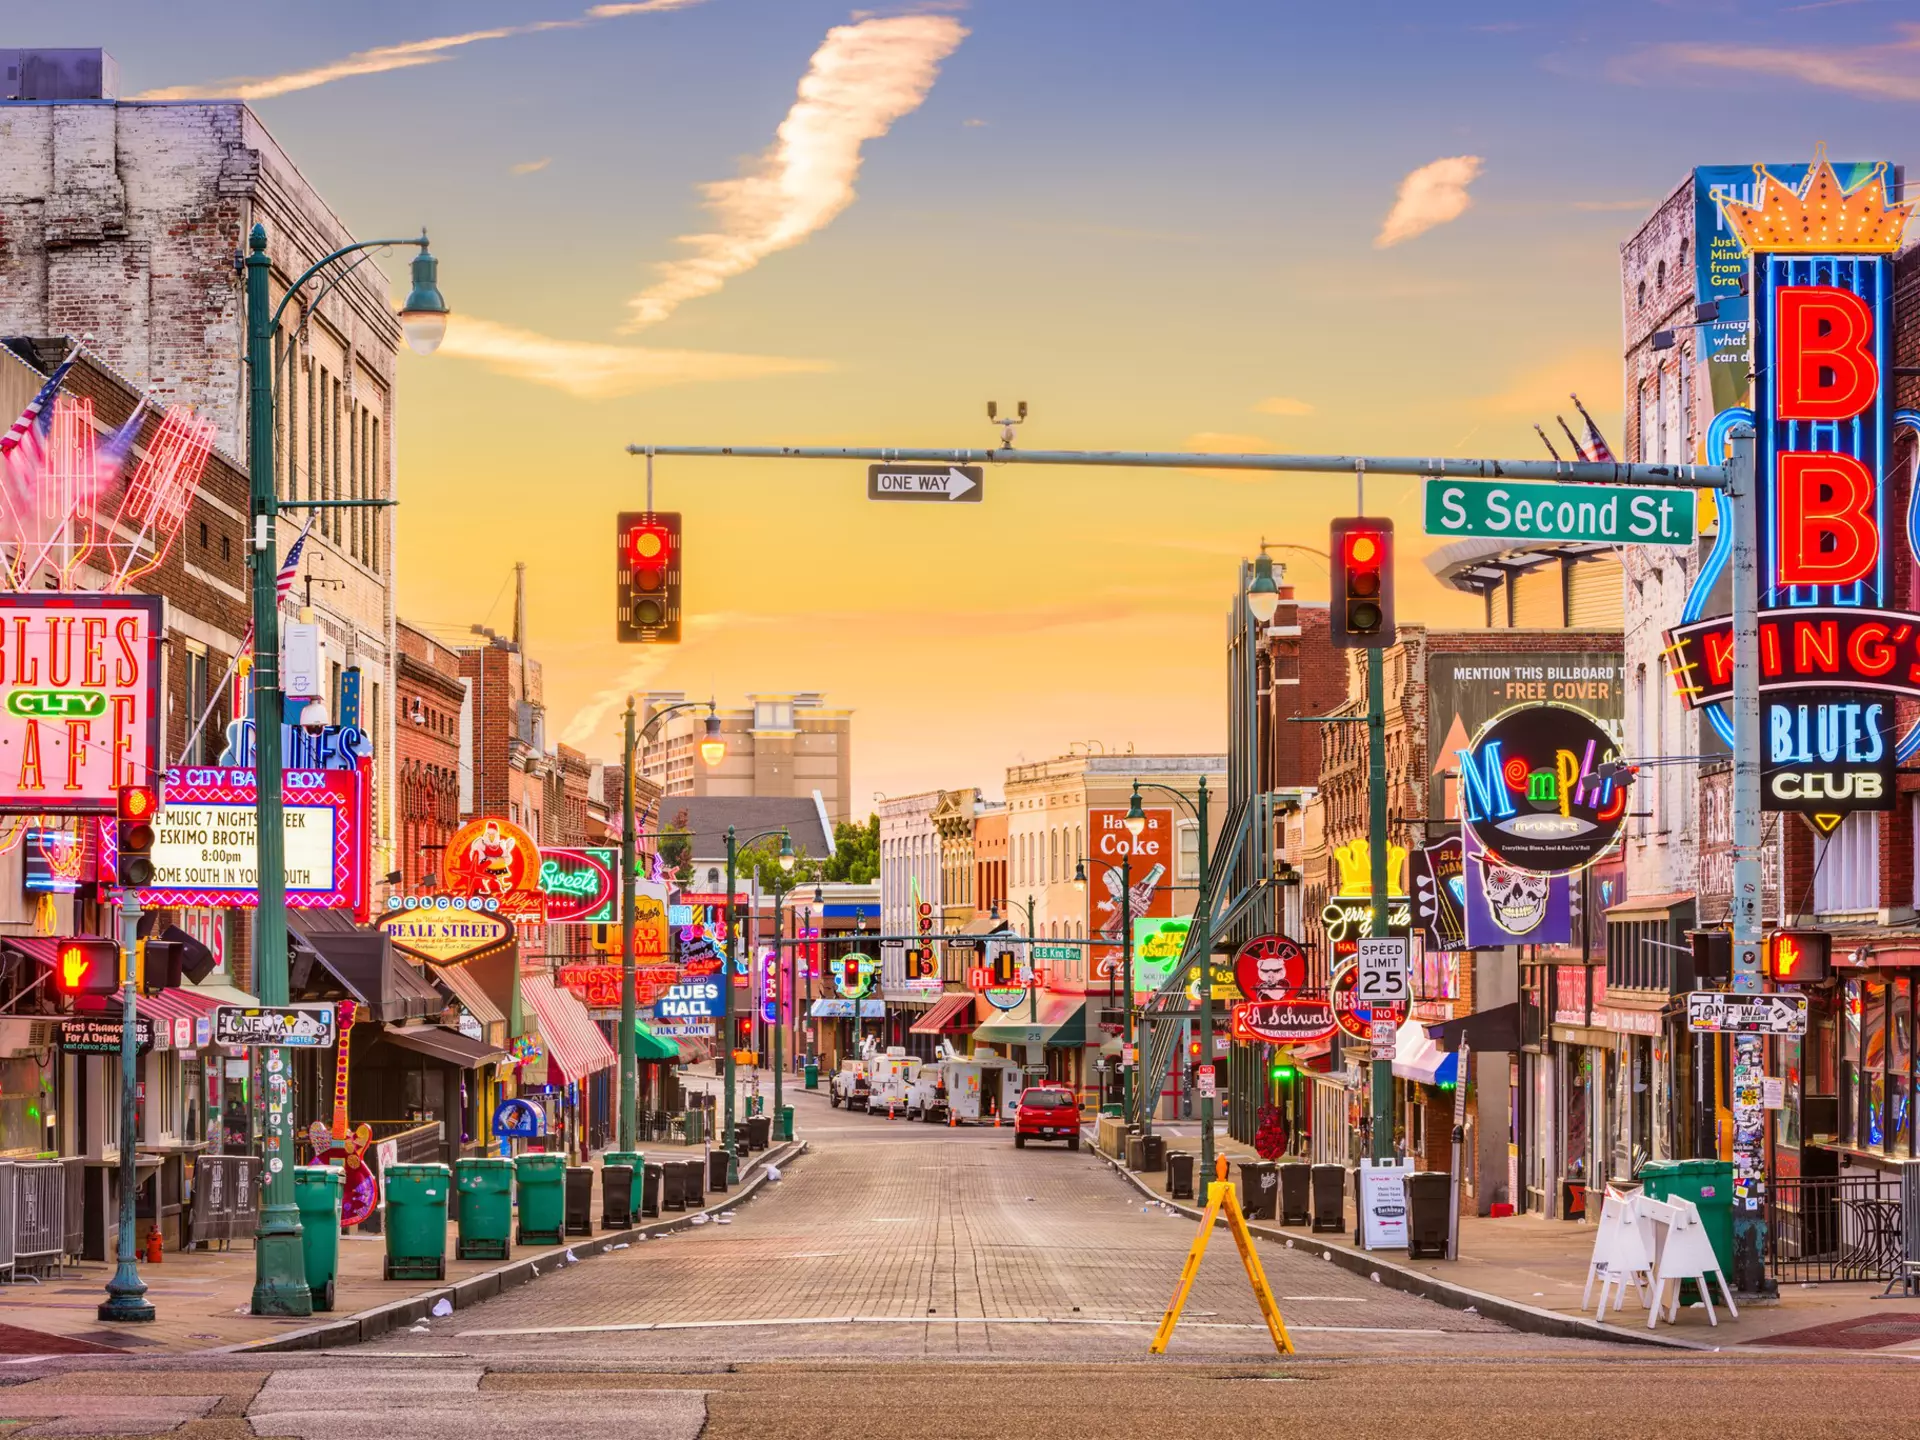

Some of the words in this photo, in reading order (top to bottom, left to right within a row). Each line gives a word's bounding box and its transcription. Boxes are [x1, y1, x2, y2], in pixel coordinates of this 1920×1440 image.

[1710, 236, 1737, 247] Just
[1711, 250, 1749, 260] Minut
[1710, 262, 1741, 273] from
[1713, 335, 1747, 346] what
[1713, 353, 1738, 363] can
[1777, 286, 1879, 420] B
[882, 476, 912, 490] ONE
[919, 477, 950, 490] WAY
[1441, 488, 1473, 530] S.
[1485, 490, 1617, 535] Second
[1629, 496, 1679, 538] St.
[1777, 451, 1880, 585] B
[1454, 667, 1510, 680] MENTION
[1515, 668, 1543, 680] THIS
[1548, 668, 1614, 680] BILLBOARD
[1506, 683, 1546, 699] FREE
[1553, 683, 1609, 699] COVER
[1771, 704, 1883, 763] BLUES
[186, 769, 226, 787] CITY
[287, 772, 325, 788] BOX
[1771, 772, 1883, 800] CLUB
[166, 812, 202, 826] MUSIC
[206, 812, 212, 826] 7
[284, 814, 306, 828] EEK
[1148, 818, 1158, 829] a
[160, 830, 207, 845] ESKIMO
[213, 832, 256, 846] BROTH
[1100, 834, 1160, 855] Coke
[201, 849, 241, 864] 8:00pm
[1440, 850, 1463, 860] BLA
[185, 869, 220, 883] SOUTH
[224, 870, 235, 883] IN
[284, 870, 310, 884] OUTH
[539, 861, 598, 896] Sweets
[388, 897, 499, 911] WELCOME
[388, 924, 436, 937] BEALE
[442, 924, 499, 937] STREET
[636, 930, 657, 940] AP
[1035, 948, 1049, 958] B.B.
[1050, 949, 1064, 958] King
[1245, 940, 1299, 960] PIG
[1338, 943, 1357, 951] HAL
[1362, 945, 1403, 956] SPEED
[1366, 958, 1398, 968] LIMIT
[564, 970, 611, 984] KING'S
[1363, 971, 1403, 993] 25
[589, 986, 651, 1002] CAE
[663, 985, 719, 999] LUES
[662, 1001, 712, 1016] HALL
[1247, 1006, 1266, 1025] A.
[1376, 1009, 1392, 1019] NO
[61, 1022, 85, 1033] First
[1341, 1013, 1360, 1032] 159
[655, 1026, 678, 1036] JUKE
[683, 1025, 710, 1034] JOINT
[1028, 1033, 1041, 1041] 25
[64, 1033, 81, 1043] For
[83, 1033, 90, 1042] A
[92, 1033, 120, 1043] Drink
[100, 1043, 108, 1051] 25
